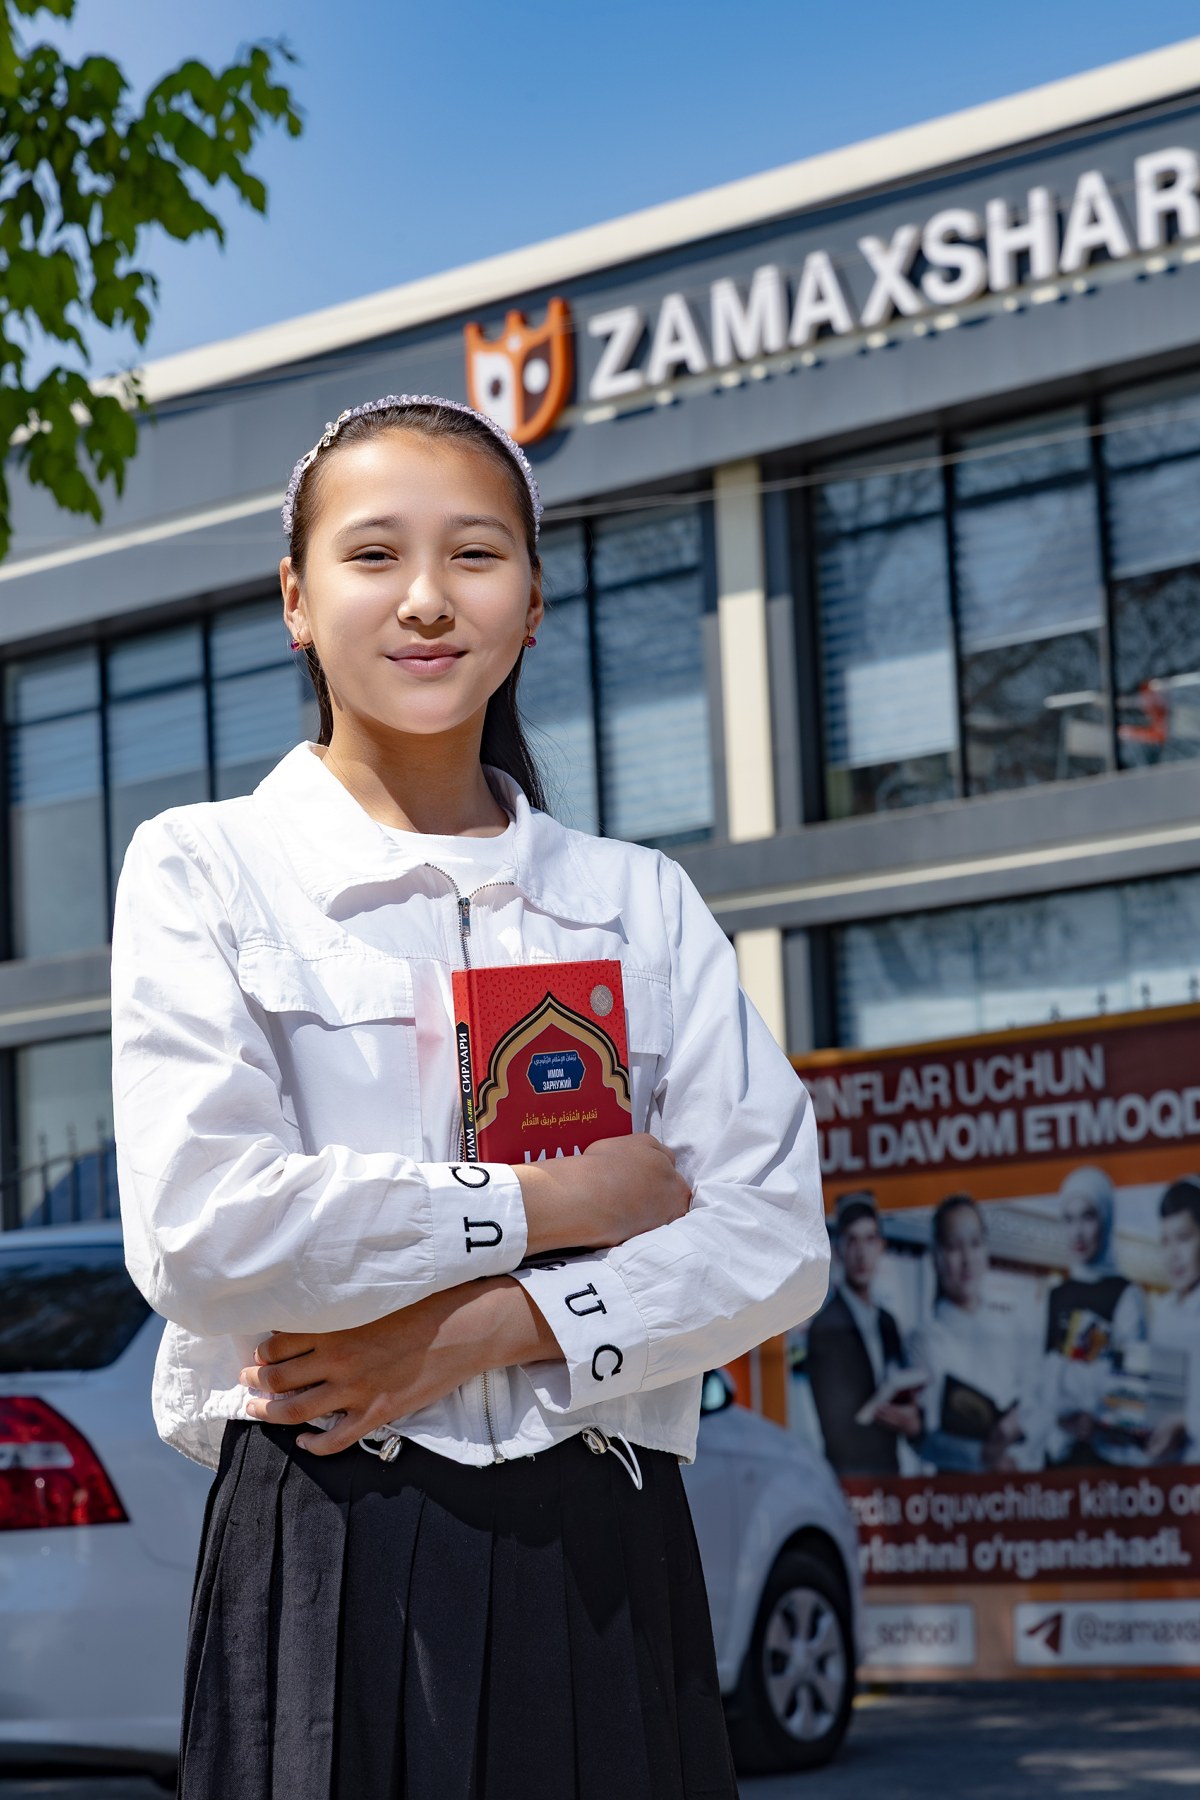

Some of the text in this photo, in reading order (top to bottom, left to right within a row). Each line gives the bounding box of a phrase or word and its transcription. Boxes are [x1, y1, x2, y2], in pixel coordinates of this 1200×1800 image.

[459, 1032, 471, 1093] СИРЛАРИ
[547, 1068, 565, 1078] ИМОМ
[955, 1044, 1106, 1108] UCHUN
[868, 1108, 1018, 1169] DAVOM
[1023, 1086, 1200, 1154] ETMOQD
[1079, 1476, 1165, 1518] kitob
